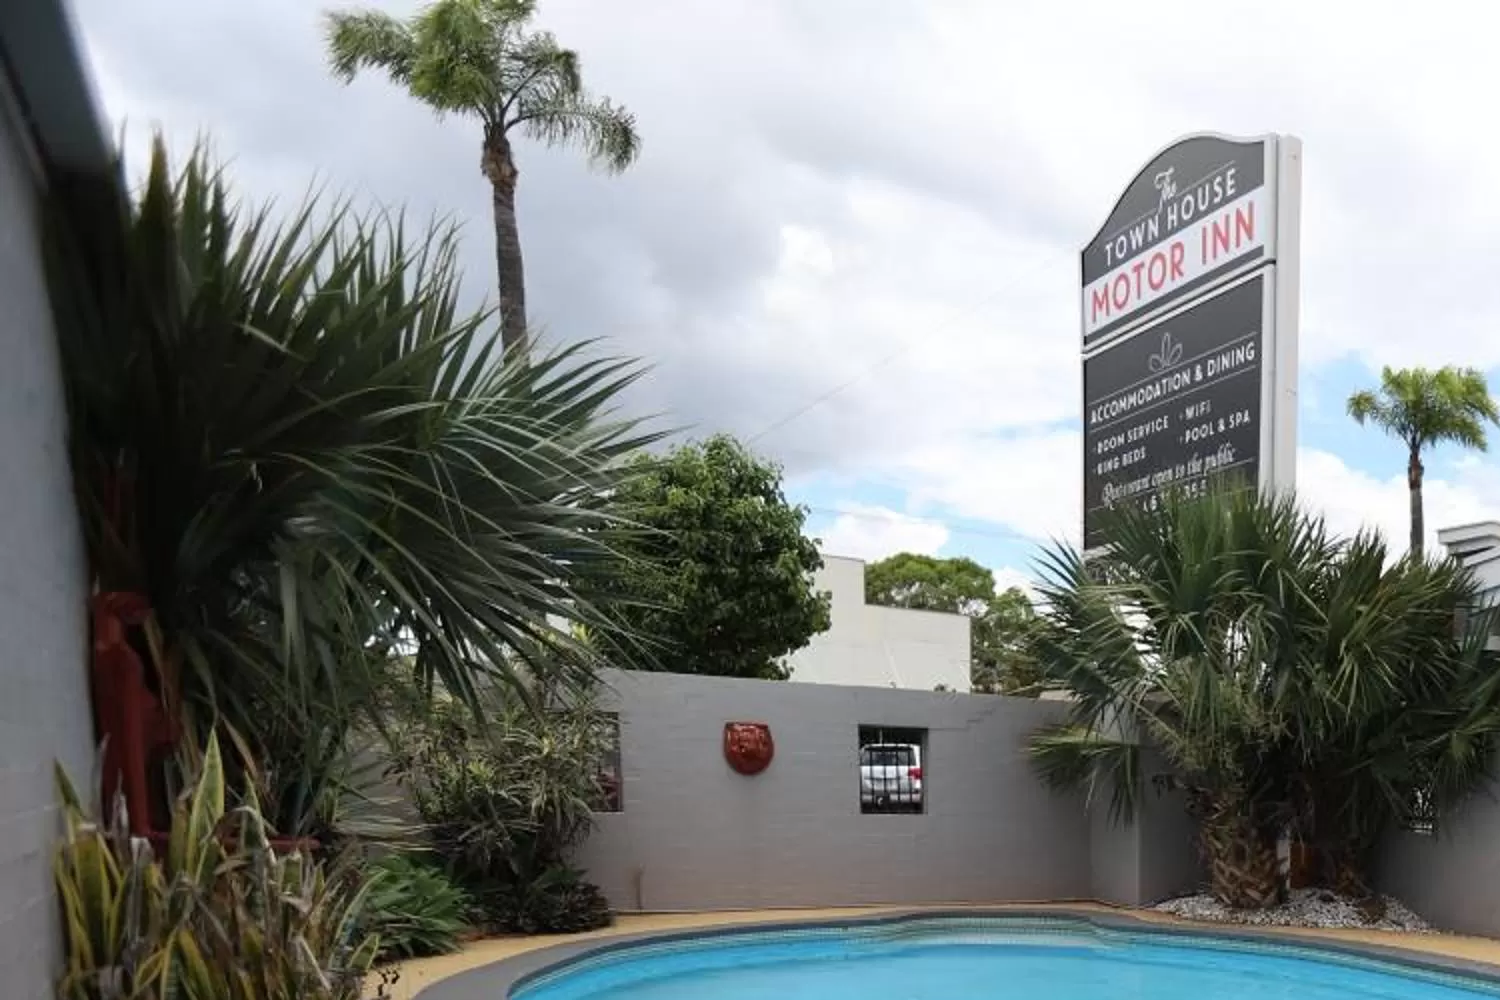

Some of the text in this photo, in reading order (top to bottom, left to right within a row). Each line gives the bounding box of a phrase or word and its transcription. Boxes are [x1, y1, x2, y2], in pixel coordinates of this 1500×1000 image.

[1154, 166, 1178, 203] The
[1105, 167, 1236, 267] TOWN HOUSE
[1091, 200, 1255, 324] MOTOR INN
[1090, 341, 1256, 425] ACCOMMODATION & DINING
[1127, 415, 1169, 443] SERVICE
[1185, 421, 1215, 444] POOL
[1229, 409, 1250, 429] SPA
